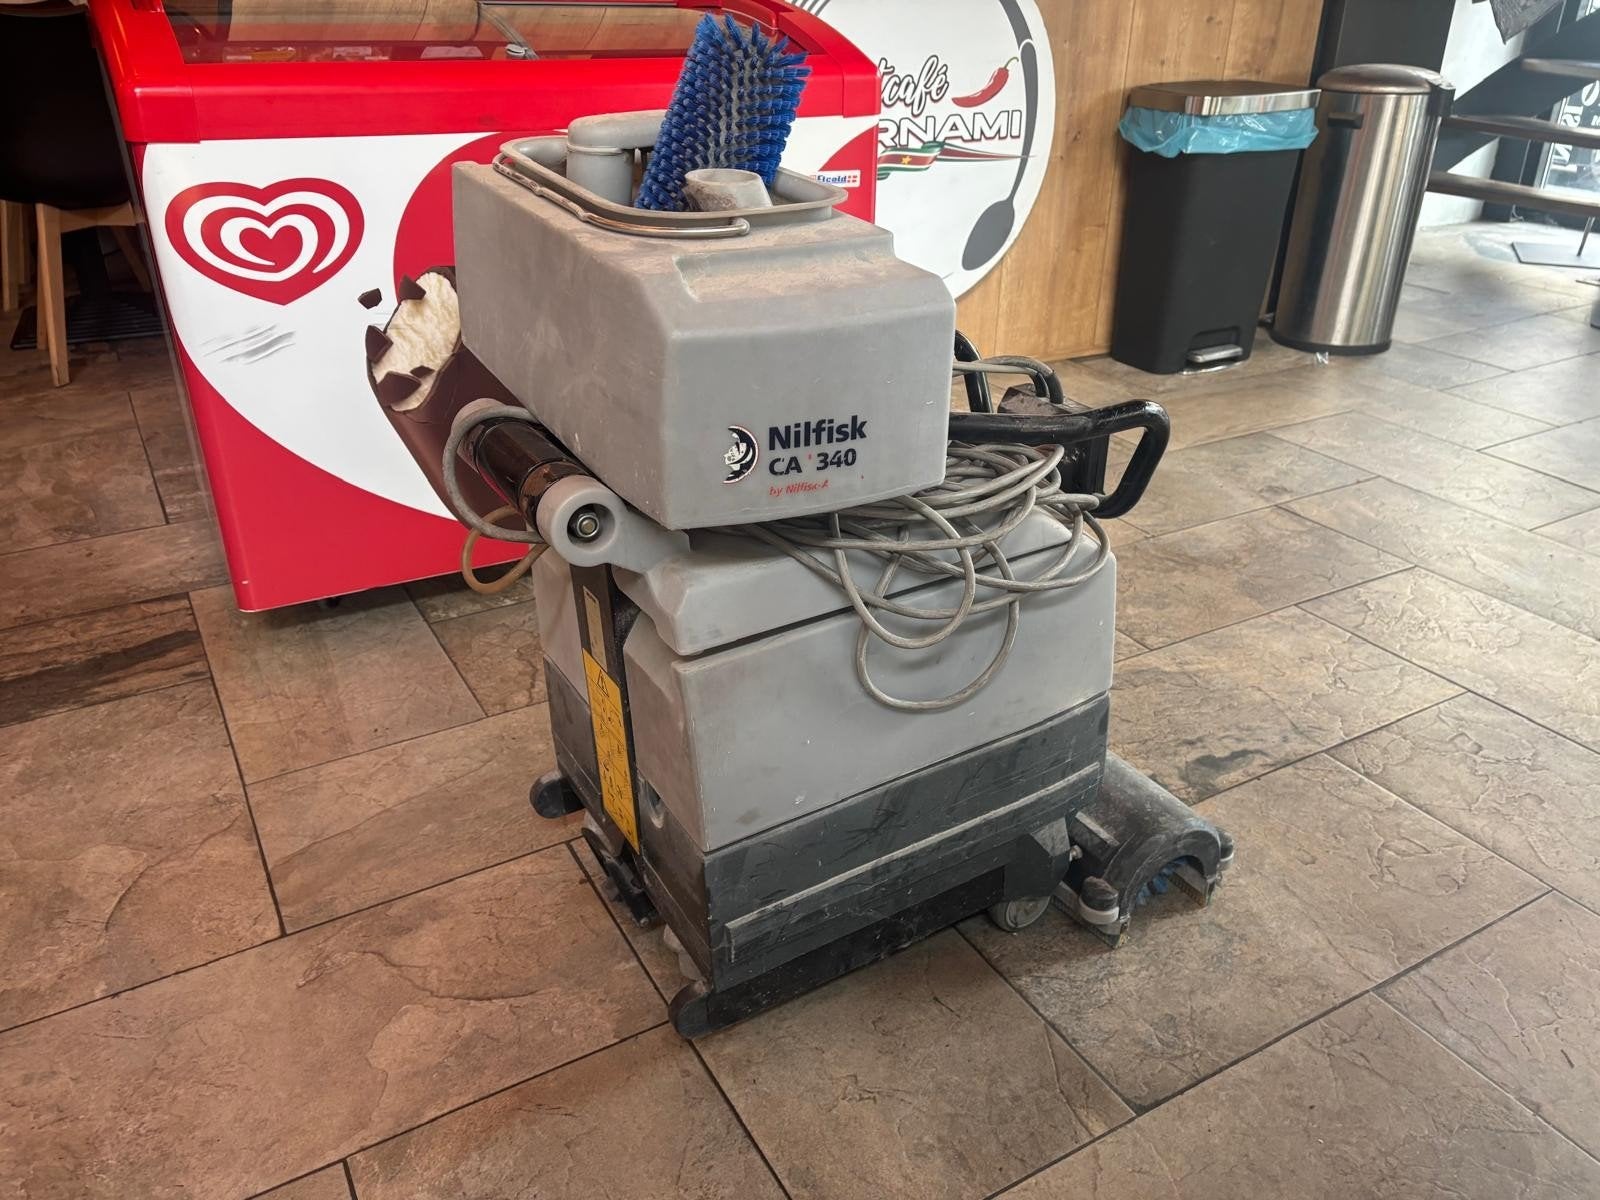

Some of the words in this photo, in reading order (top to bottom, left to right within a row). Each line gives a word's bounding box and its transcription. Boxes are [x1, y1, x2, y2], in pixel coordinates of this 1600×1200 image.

[768, 415, 867, 450] Nilfisk
[768, 456, 802, 476] CA
[816, 448, 857, 471] 340
[769, 486, 782, 497] by
